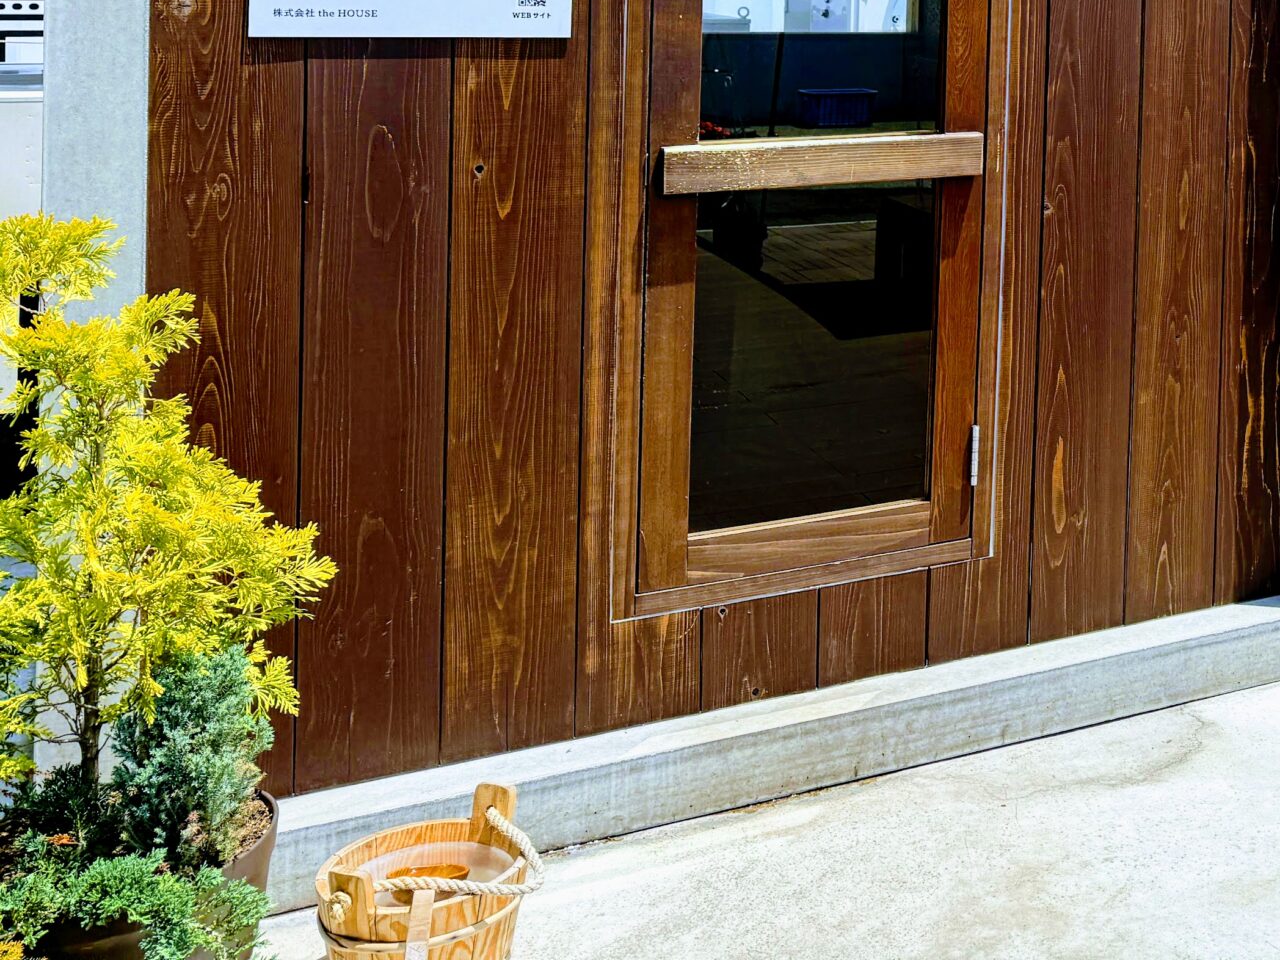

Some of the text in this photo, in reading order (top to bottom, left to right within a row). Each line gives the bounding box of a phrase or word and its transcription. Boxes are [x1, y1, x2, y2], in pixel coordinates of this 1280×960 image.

[273, 7, 379, 19] 株式会社 the HOUSE
